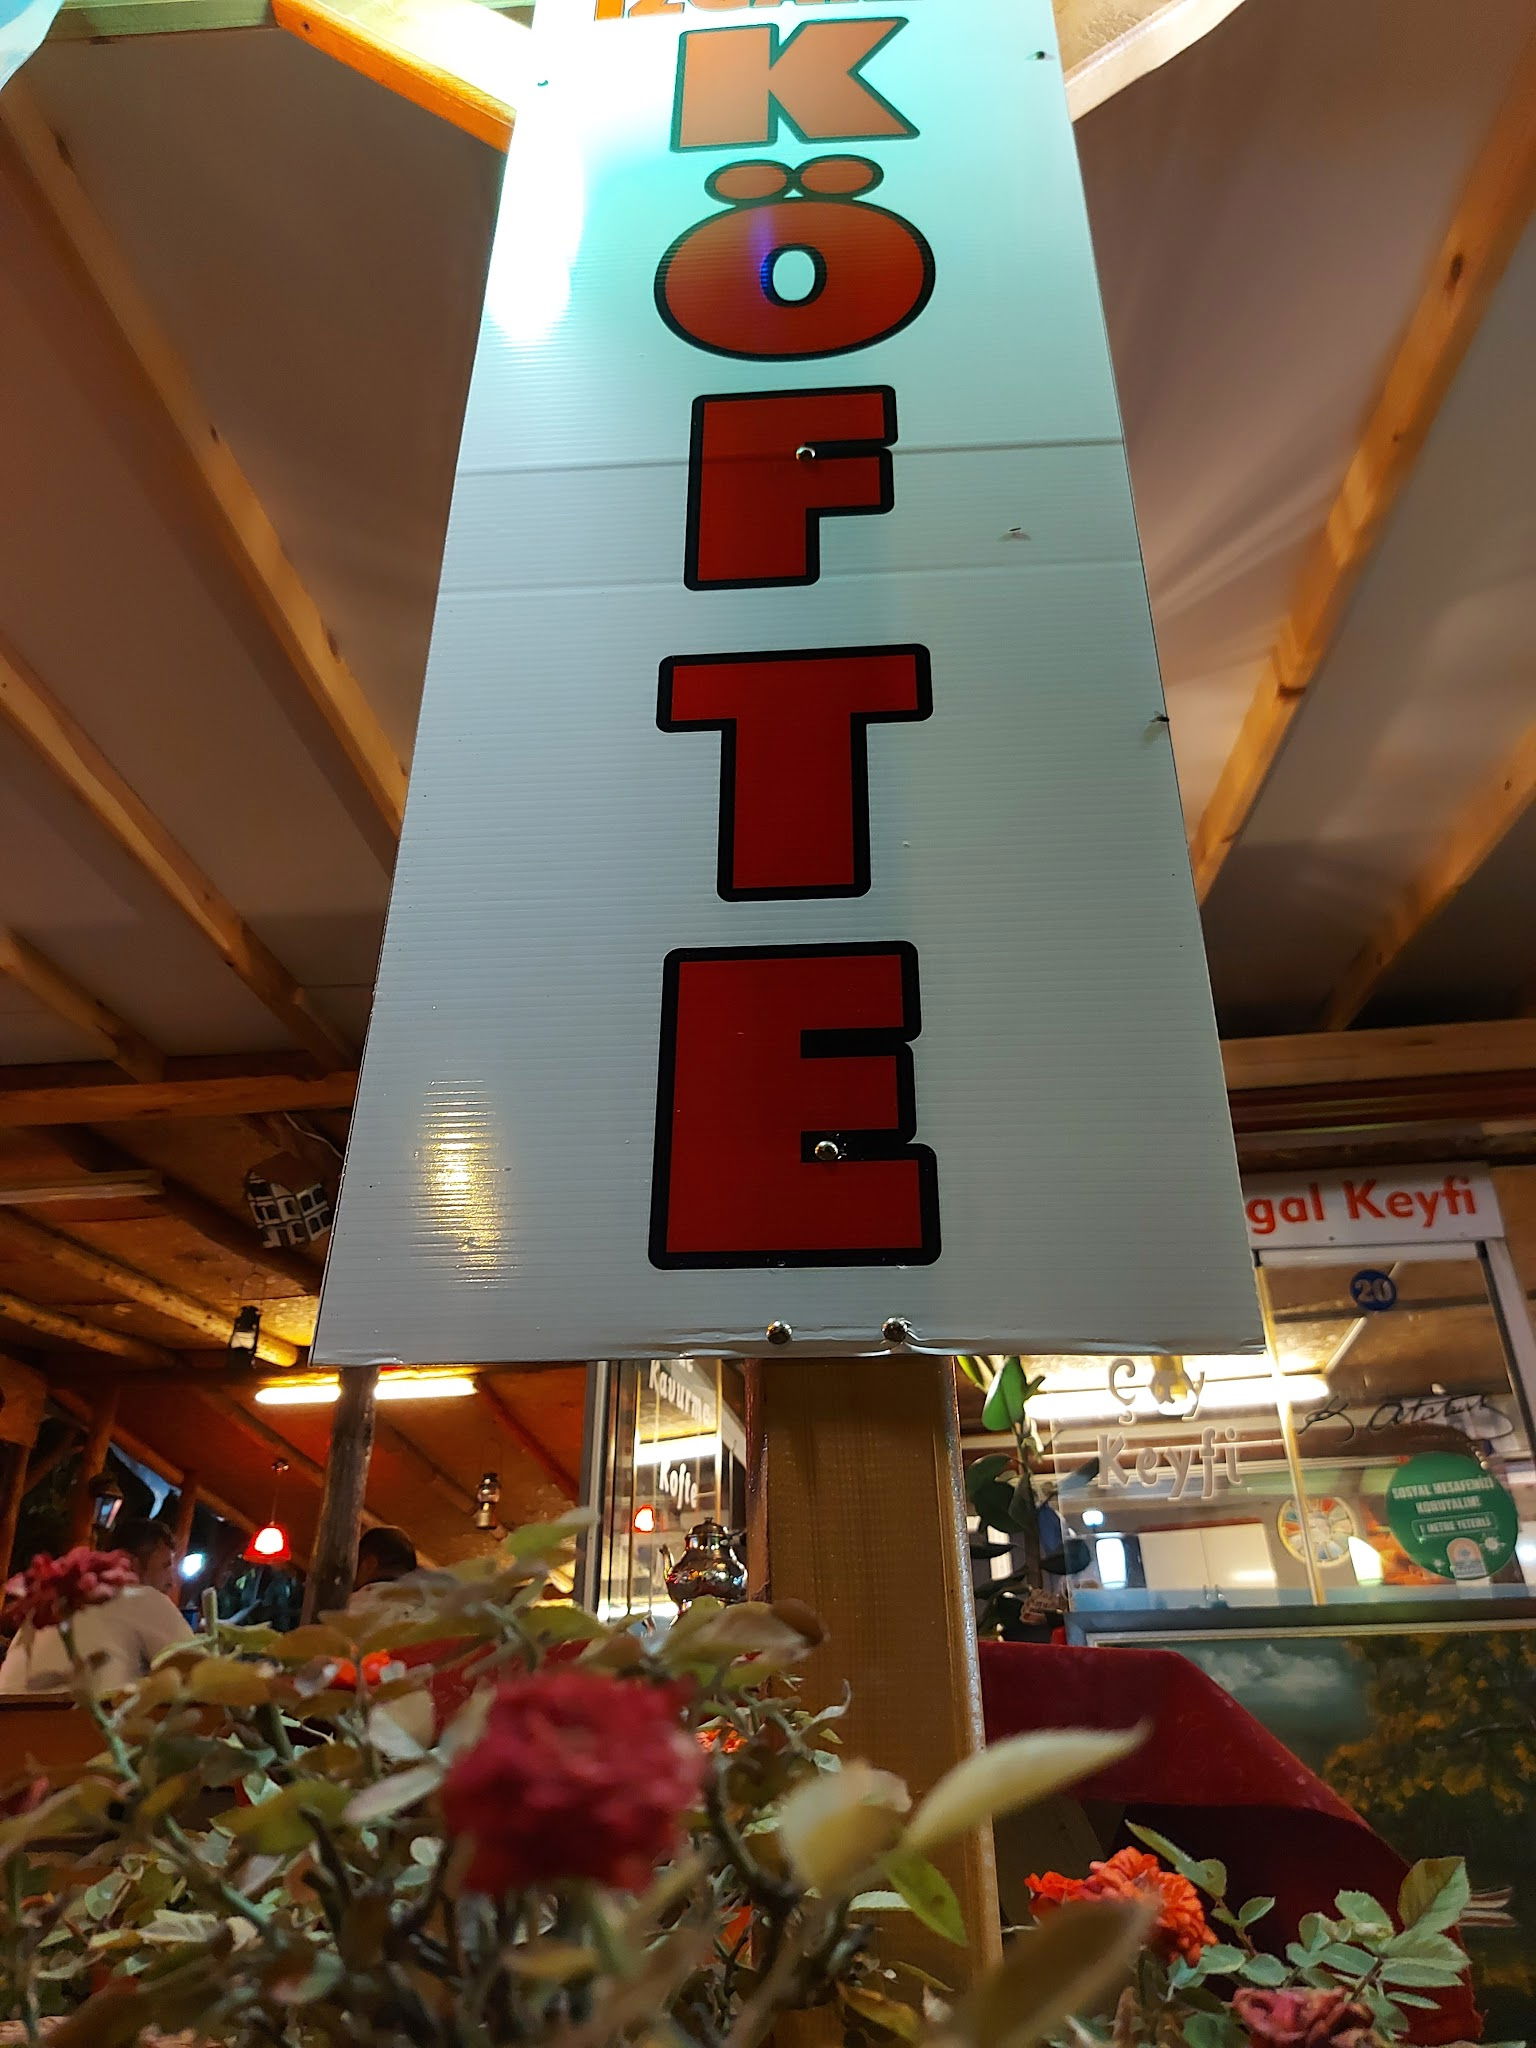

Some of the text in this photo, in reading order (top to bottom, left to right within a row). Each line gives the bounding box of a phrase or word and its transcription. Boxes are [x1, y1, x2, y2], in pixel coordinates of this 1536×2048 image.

[649, 16, 942, 1270] KÖFTE
[1343, 1175, 1477, 1228] Keyfi
[1354, 1279, 1391, 1303] 20
[1097, 1427, 1242, 1500] Keyfi
